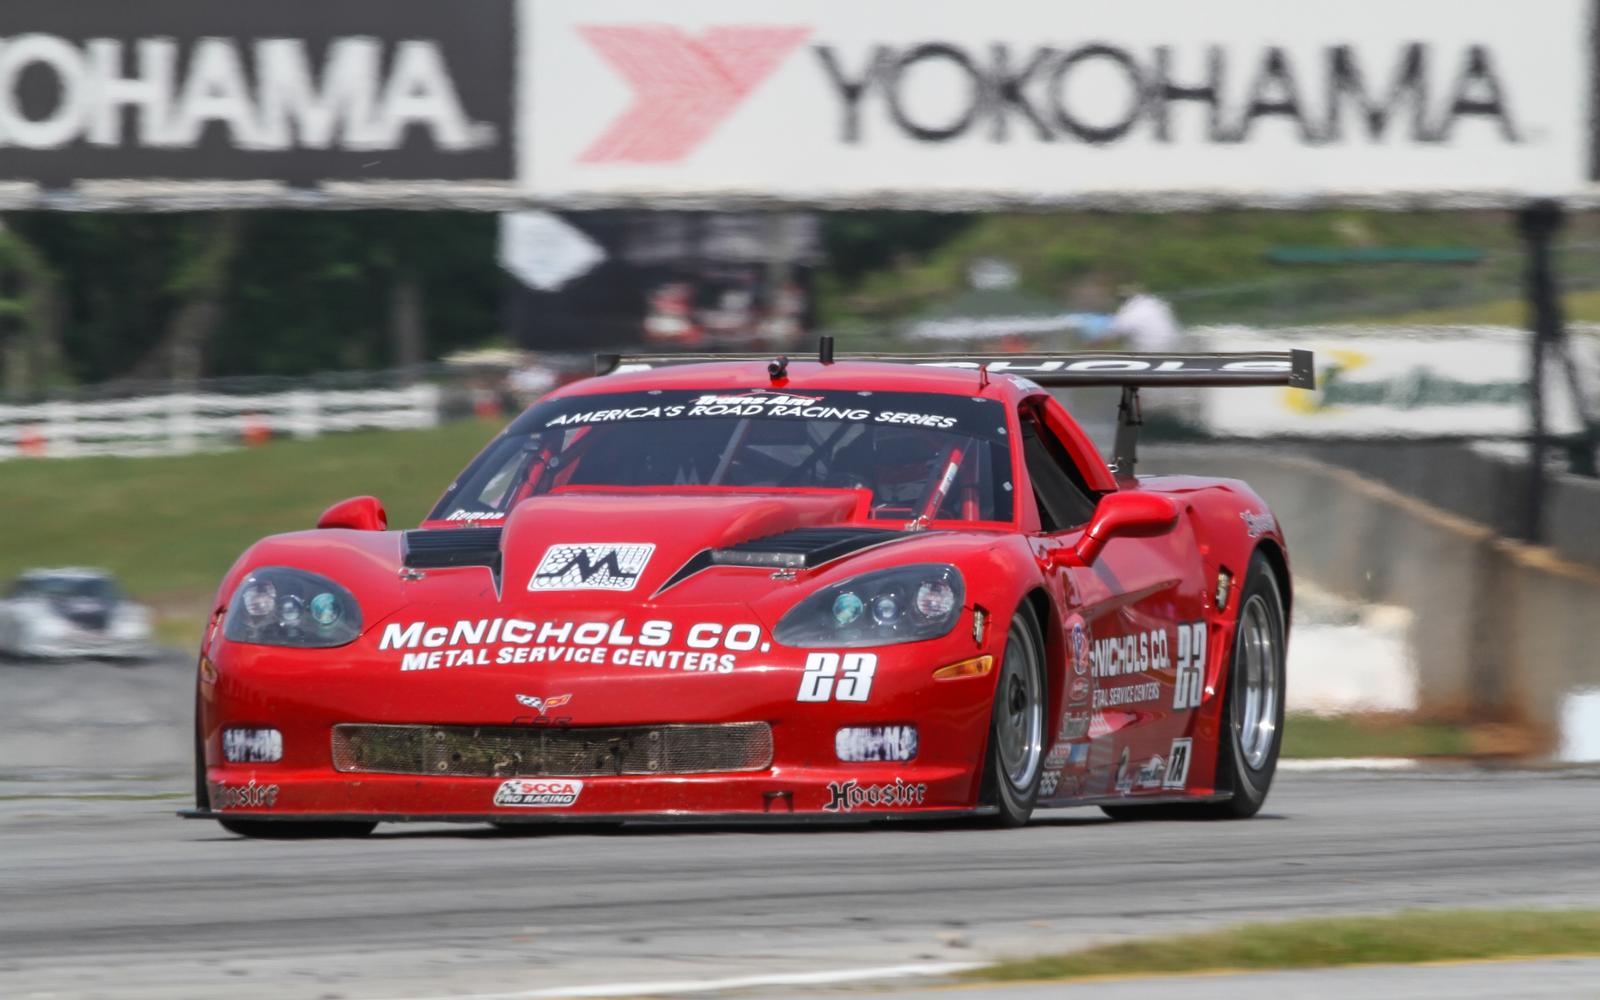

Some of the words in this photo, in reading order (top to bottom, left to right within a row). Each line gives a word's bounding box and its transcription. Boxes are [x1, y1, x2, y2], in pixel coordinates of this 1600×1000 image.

[0, 33, 472, 151] OHAMA
[812, 42, 1522, 144] YOKOHAMA
[545, 406, 685, 427] AMERICA'S
[688, 405, 763, 416] ROAD
[768, 406, 870, 420] RACING
[875, 411, 957, 428] SERIES
[379, 618, 673, 650] McNICHOLS
[687, 623, 771, 653] CO.
[401, 649, 490, 671] METAL
[496, 647, 607, 664] SERVICE
[612, 650, 736, 674] CENTERS
[796, 652, 878, 702] 23
[1172, 621, 1208, 709] 23
[522, 784, 575, 794] SCCA
[523, 794, 573, 804] RACING
[823, 777, 927, 812] Hoosier
